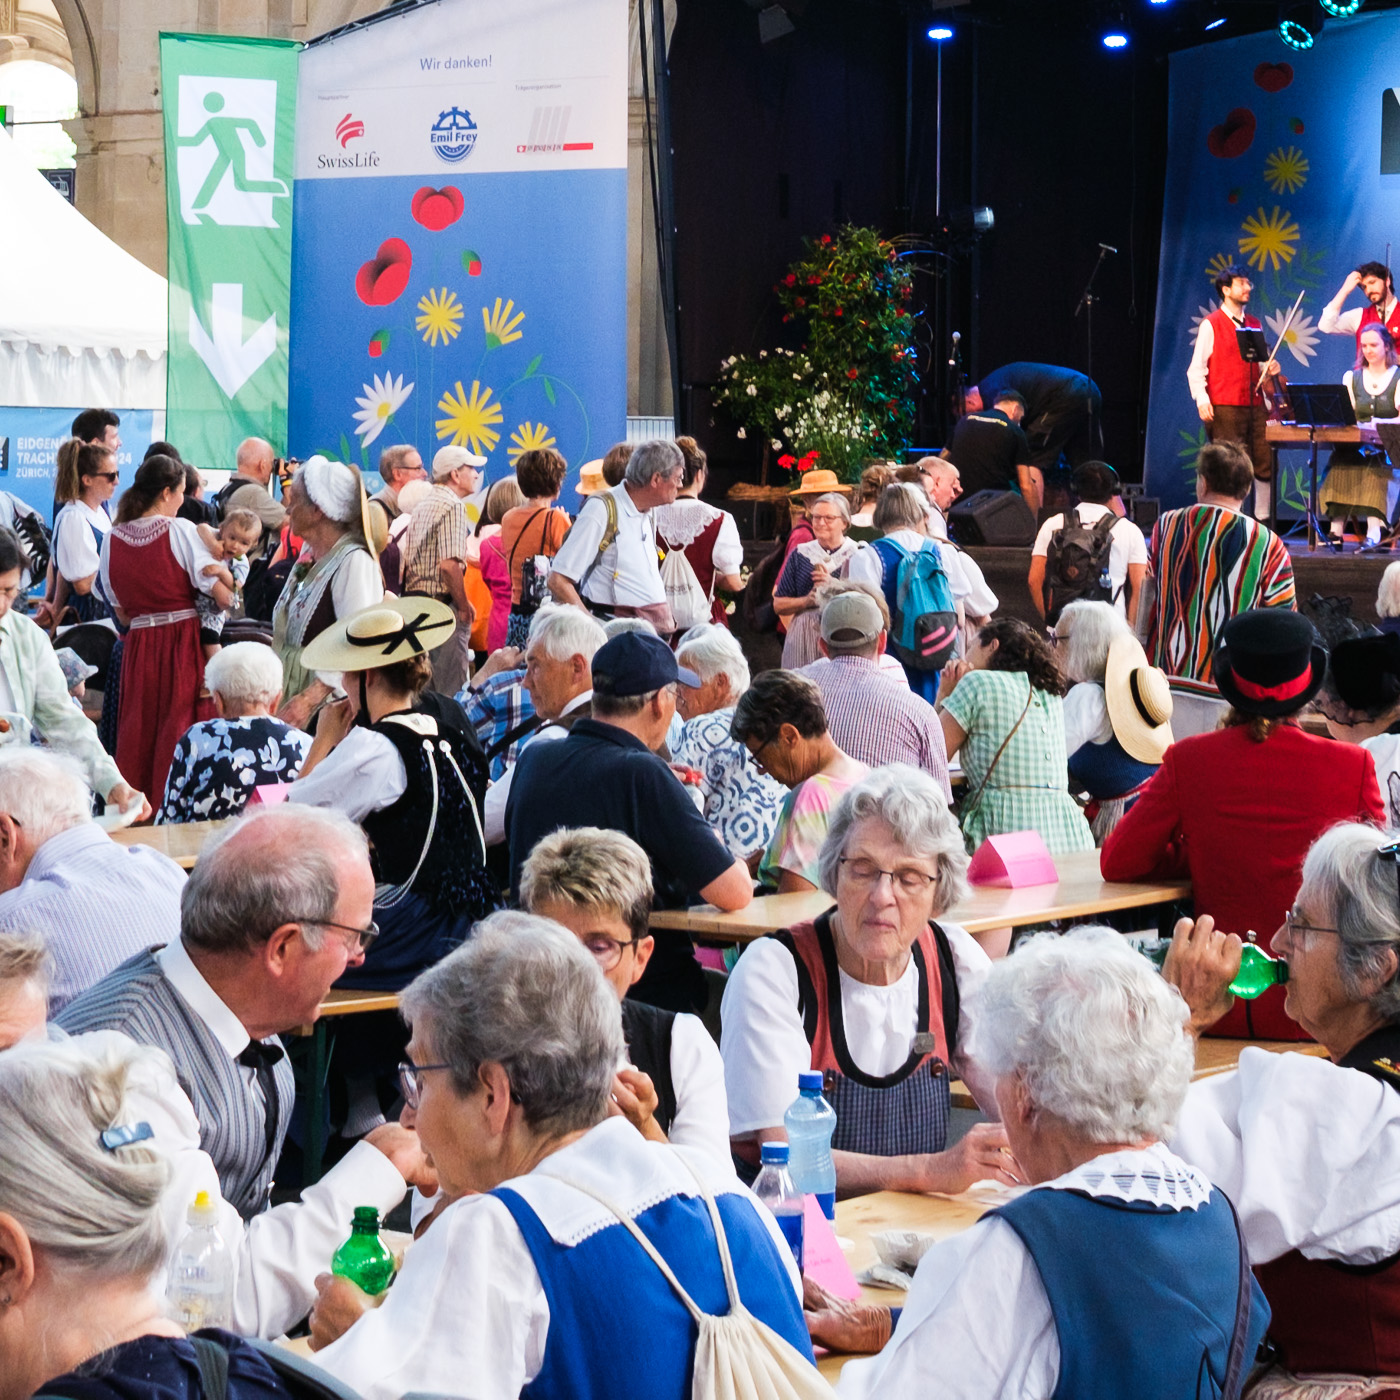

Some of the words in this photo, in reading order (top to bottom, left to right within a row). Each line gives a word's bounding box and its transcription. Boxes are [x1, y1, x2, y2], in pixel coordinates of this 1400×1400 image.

[420, 57, 442, 71] Wir
[444, 54, 493, 70] danken!
[430, 131, 453, 144] Emil
[455, 131, 478, 145] Frey
[16, 452, 57, 464] TRACH
[16, 467, 51, 478] ZÜRICH,
